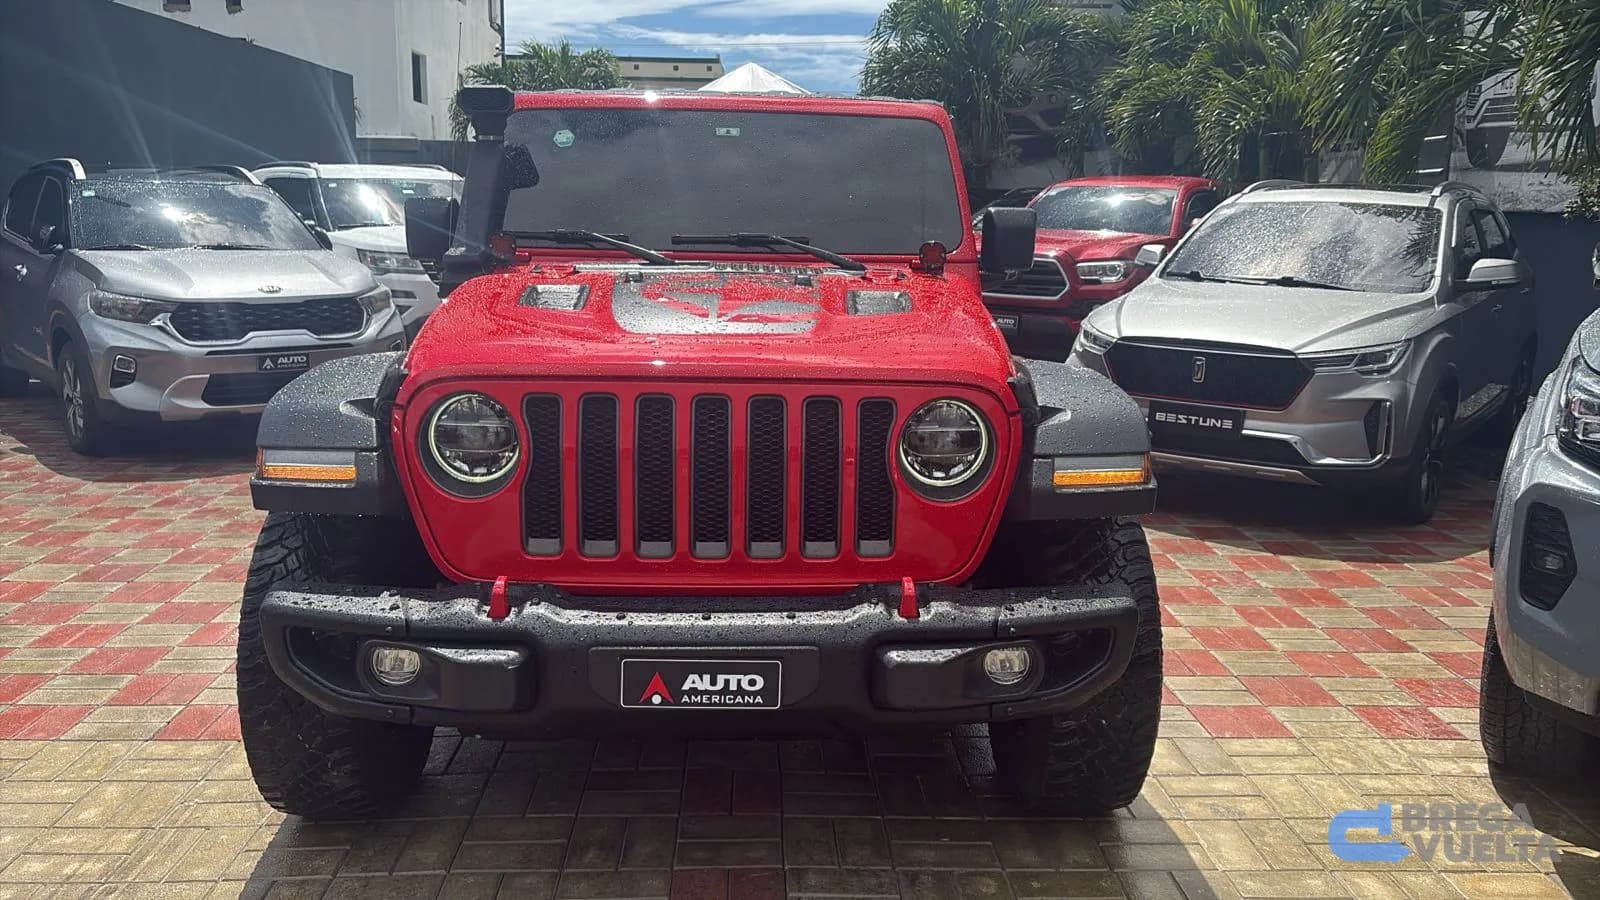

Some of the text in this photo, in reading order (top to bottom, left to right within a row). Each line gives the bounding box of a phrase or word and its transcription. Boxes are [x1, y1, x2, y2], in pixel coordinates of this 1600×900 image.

[277, 355, 307, 364] AUTO
[1155, 412, 1233, 429] BESTUNE
[681, 674, 764, 691] AUTO
[681, 694, 763, 704] AMERICANA
